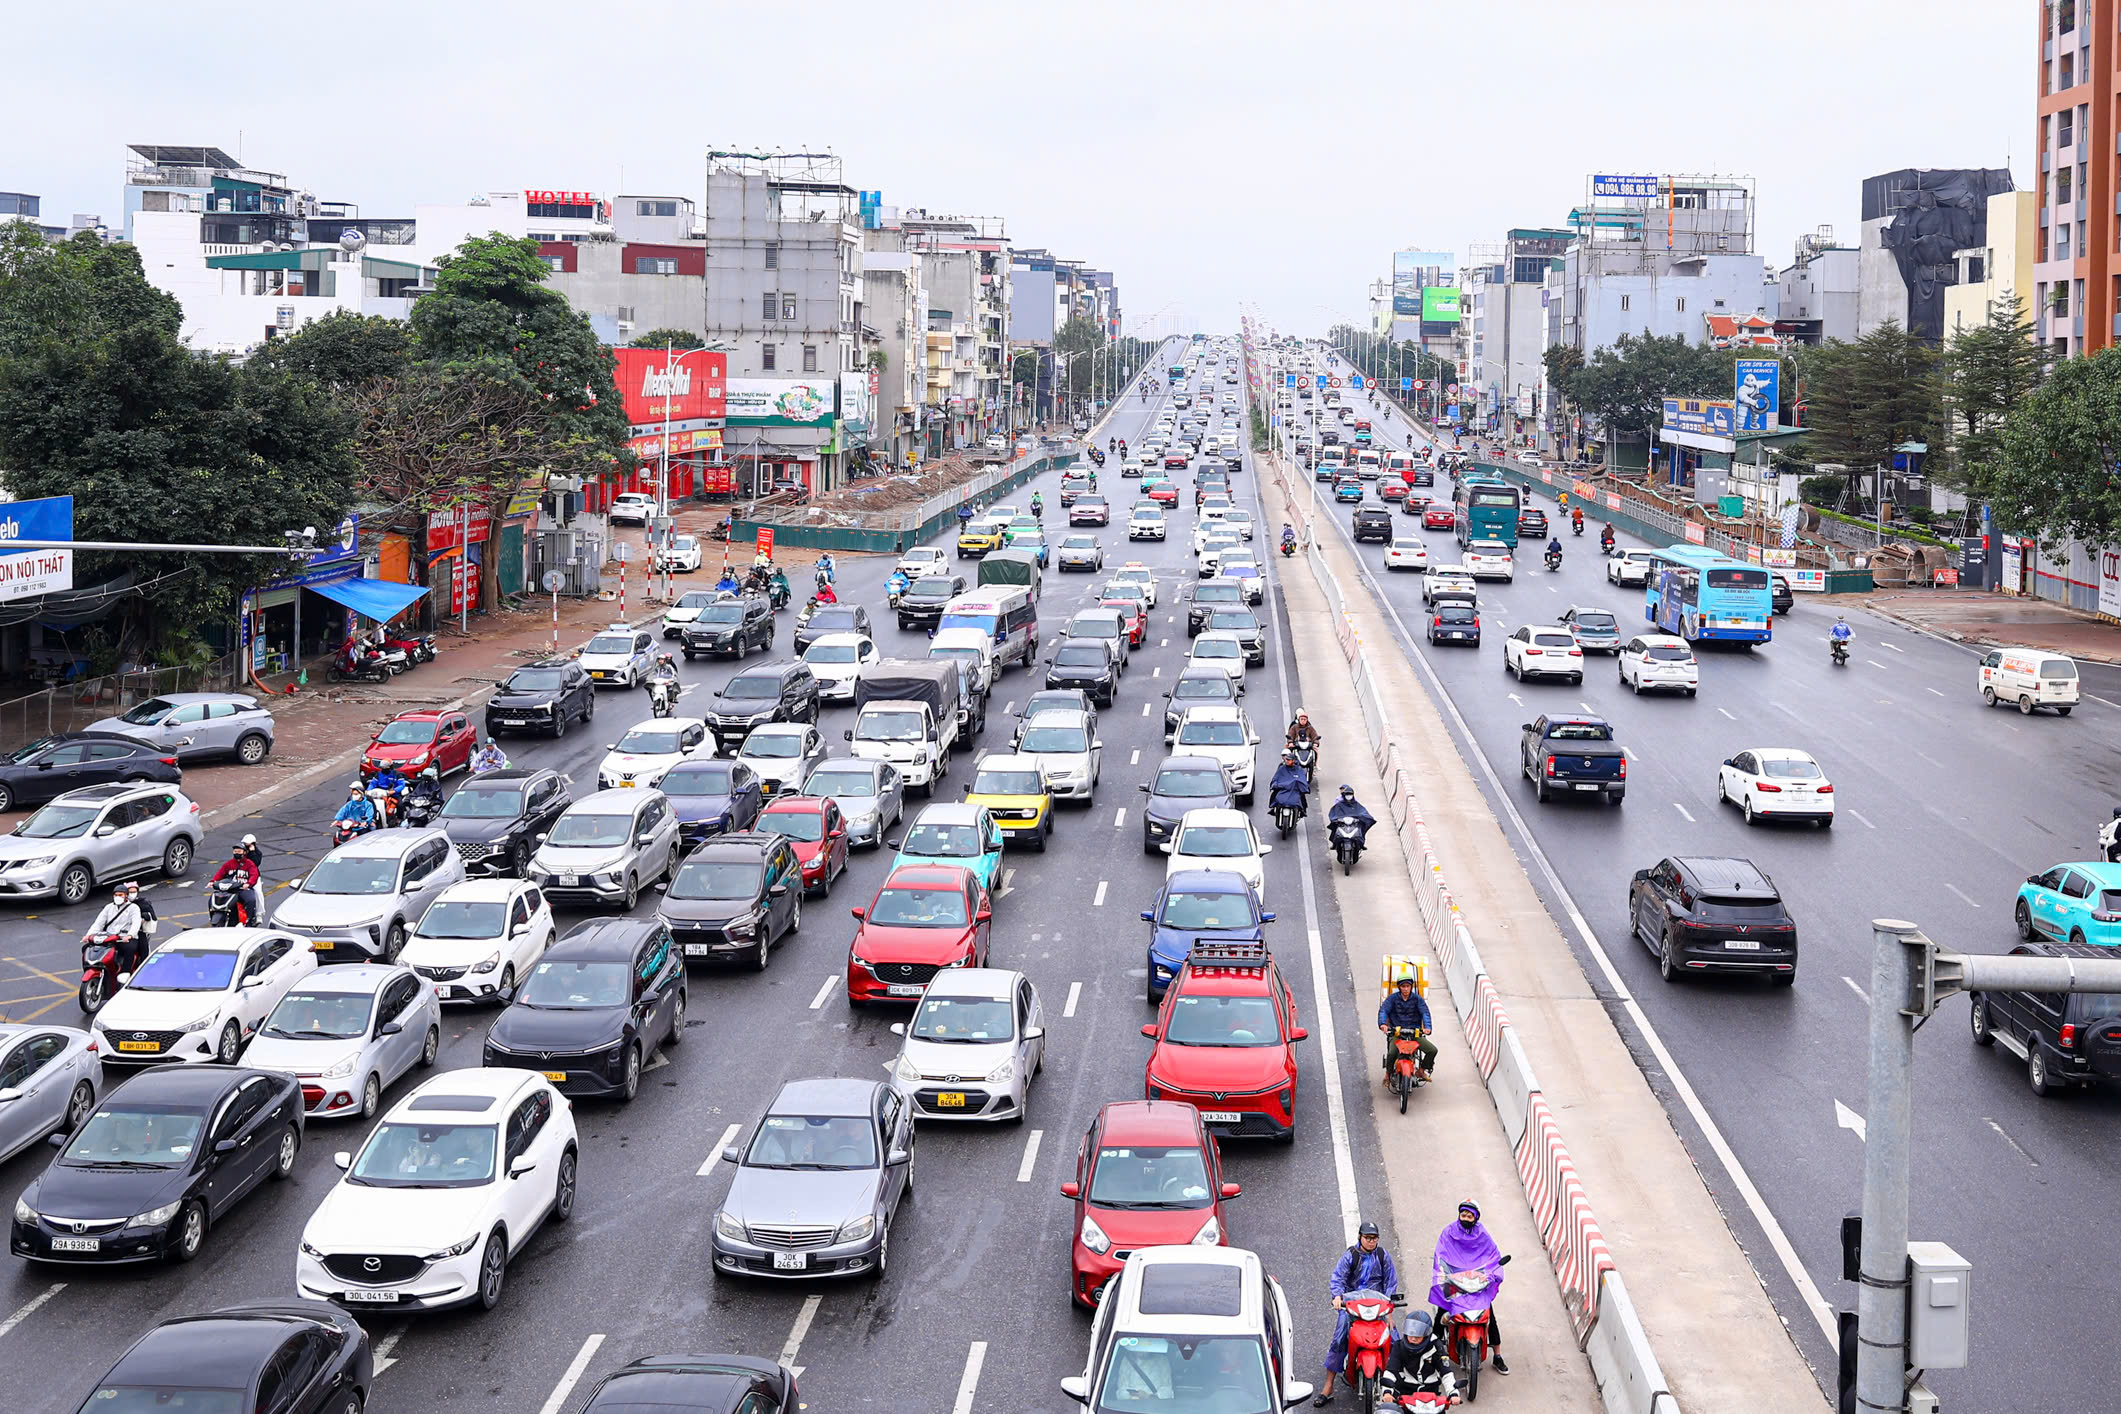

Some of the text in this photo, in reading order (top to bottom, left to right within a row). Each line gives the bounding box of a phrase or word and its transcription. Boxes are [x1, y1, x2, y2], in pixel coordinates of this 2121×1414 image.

[524, 190, 597, 206] HOTEL
[17, 556, 35, 581] NỘI
[38, 551, 64, 576] THẤT
